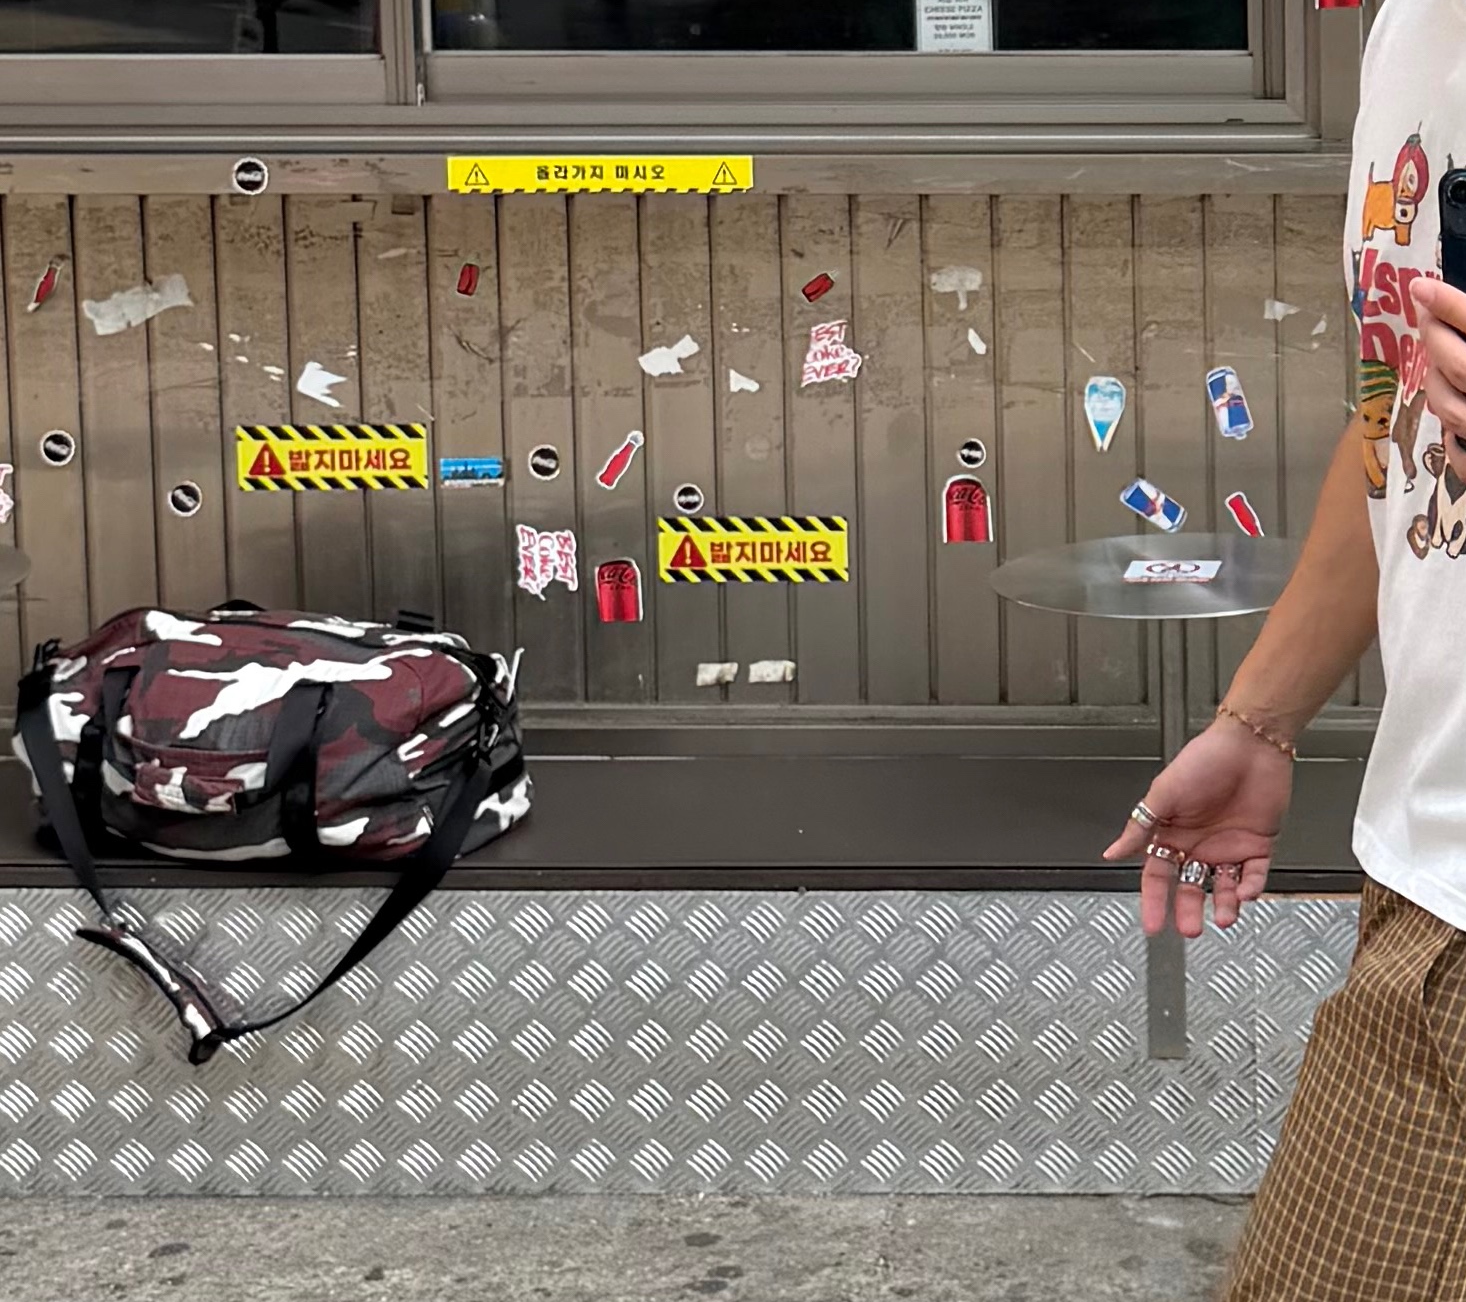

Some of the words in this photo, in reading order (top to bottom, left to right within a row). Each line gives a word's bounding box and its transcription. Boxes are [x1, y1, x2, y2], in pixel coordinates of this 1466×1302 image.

[536, 164, 604, 180] 올라가지
[615, 164, 665, 180] 마시오
[288, 448, 412, 472] 밟지마세요
[710, 540, 833, 564] 밟지마세요
